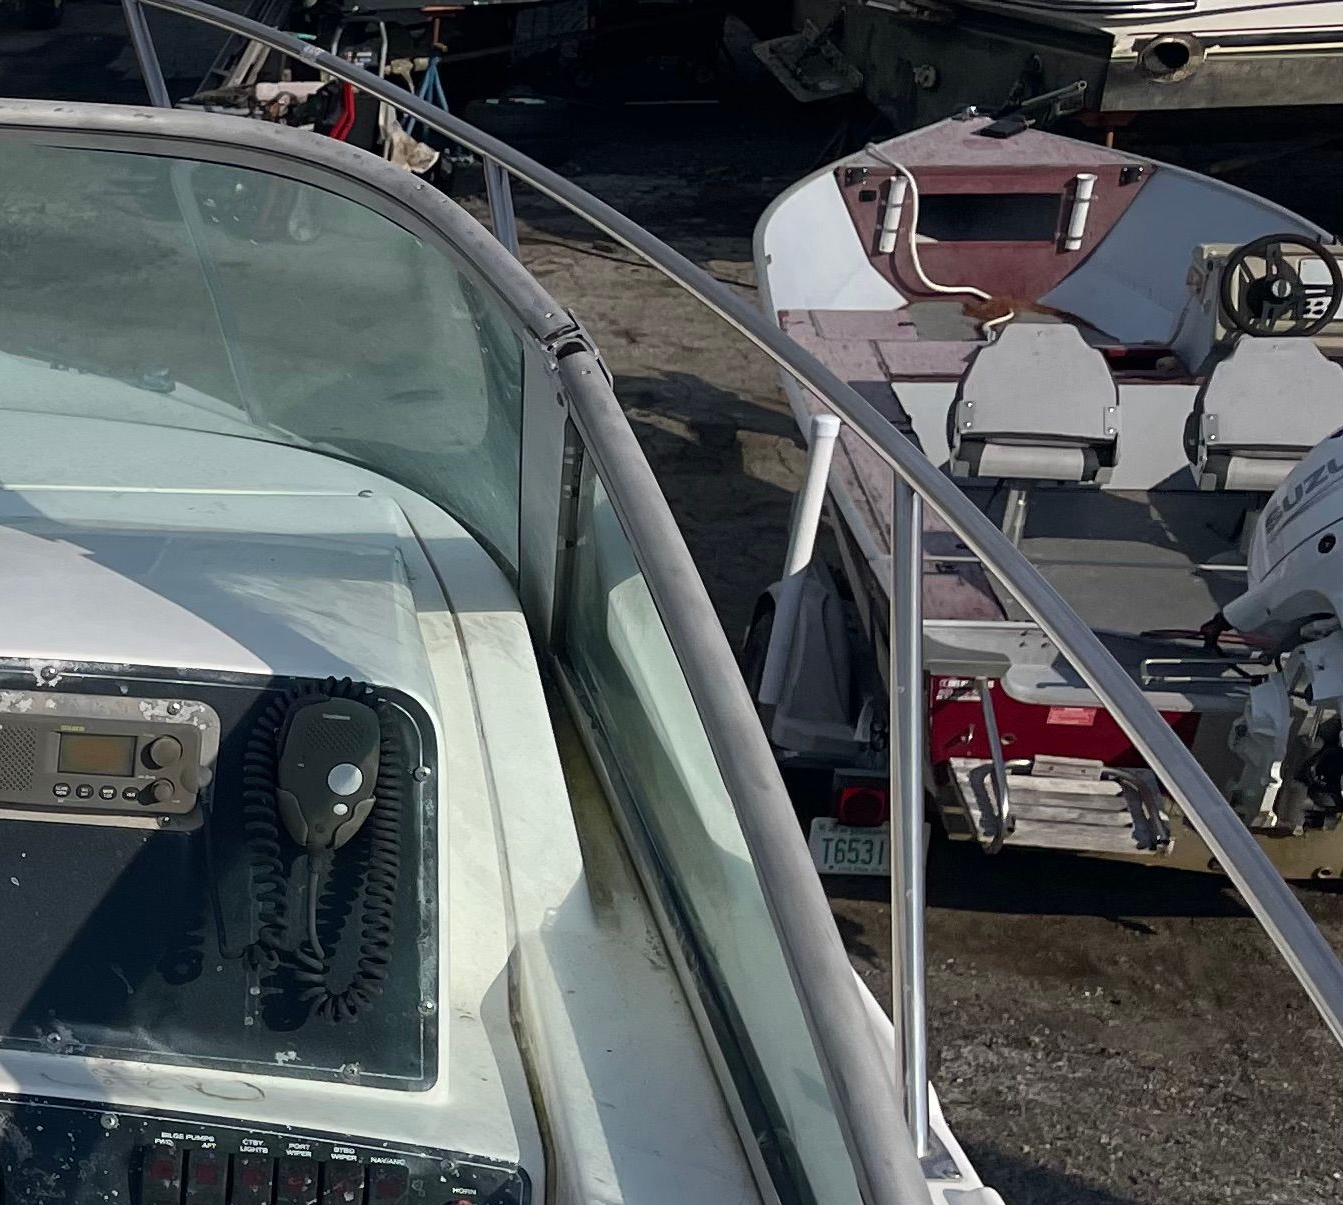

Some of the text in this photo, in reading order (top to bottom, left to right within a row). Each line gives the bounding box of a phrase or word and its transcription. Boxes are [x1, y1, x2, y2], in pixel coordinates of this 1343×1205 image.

[186, 1134, 215, 1142] PUMPS
[239, 1146, 268, 1154] LIGHTS
[286, 1149, 311, 1157] WIPER
[330, 1153, 357, 1162] WIPER
[452, 1187, 477, 1195] HORN
